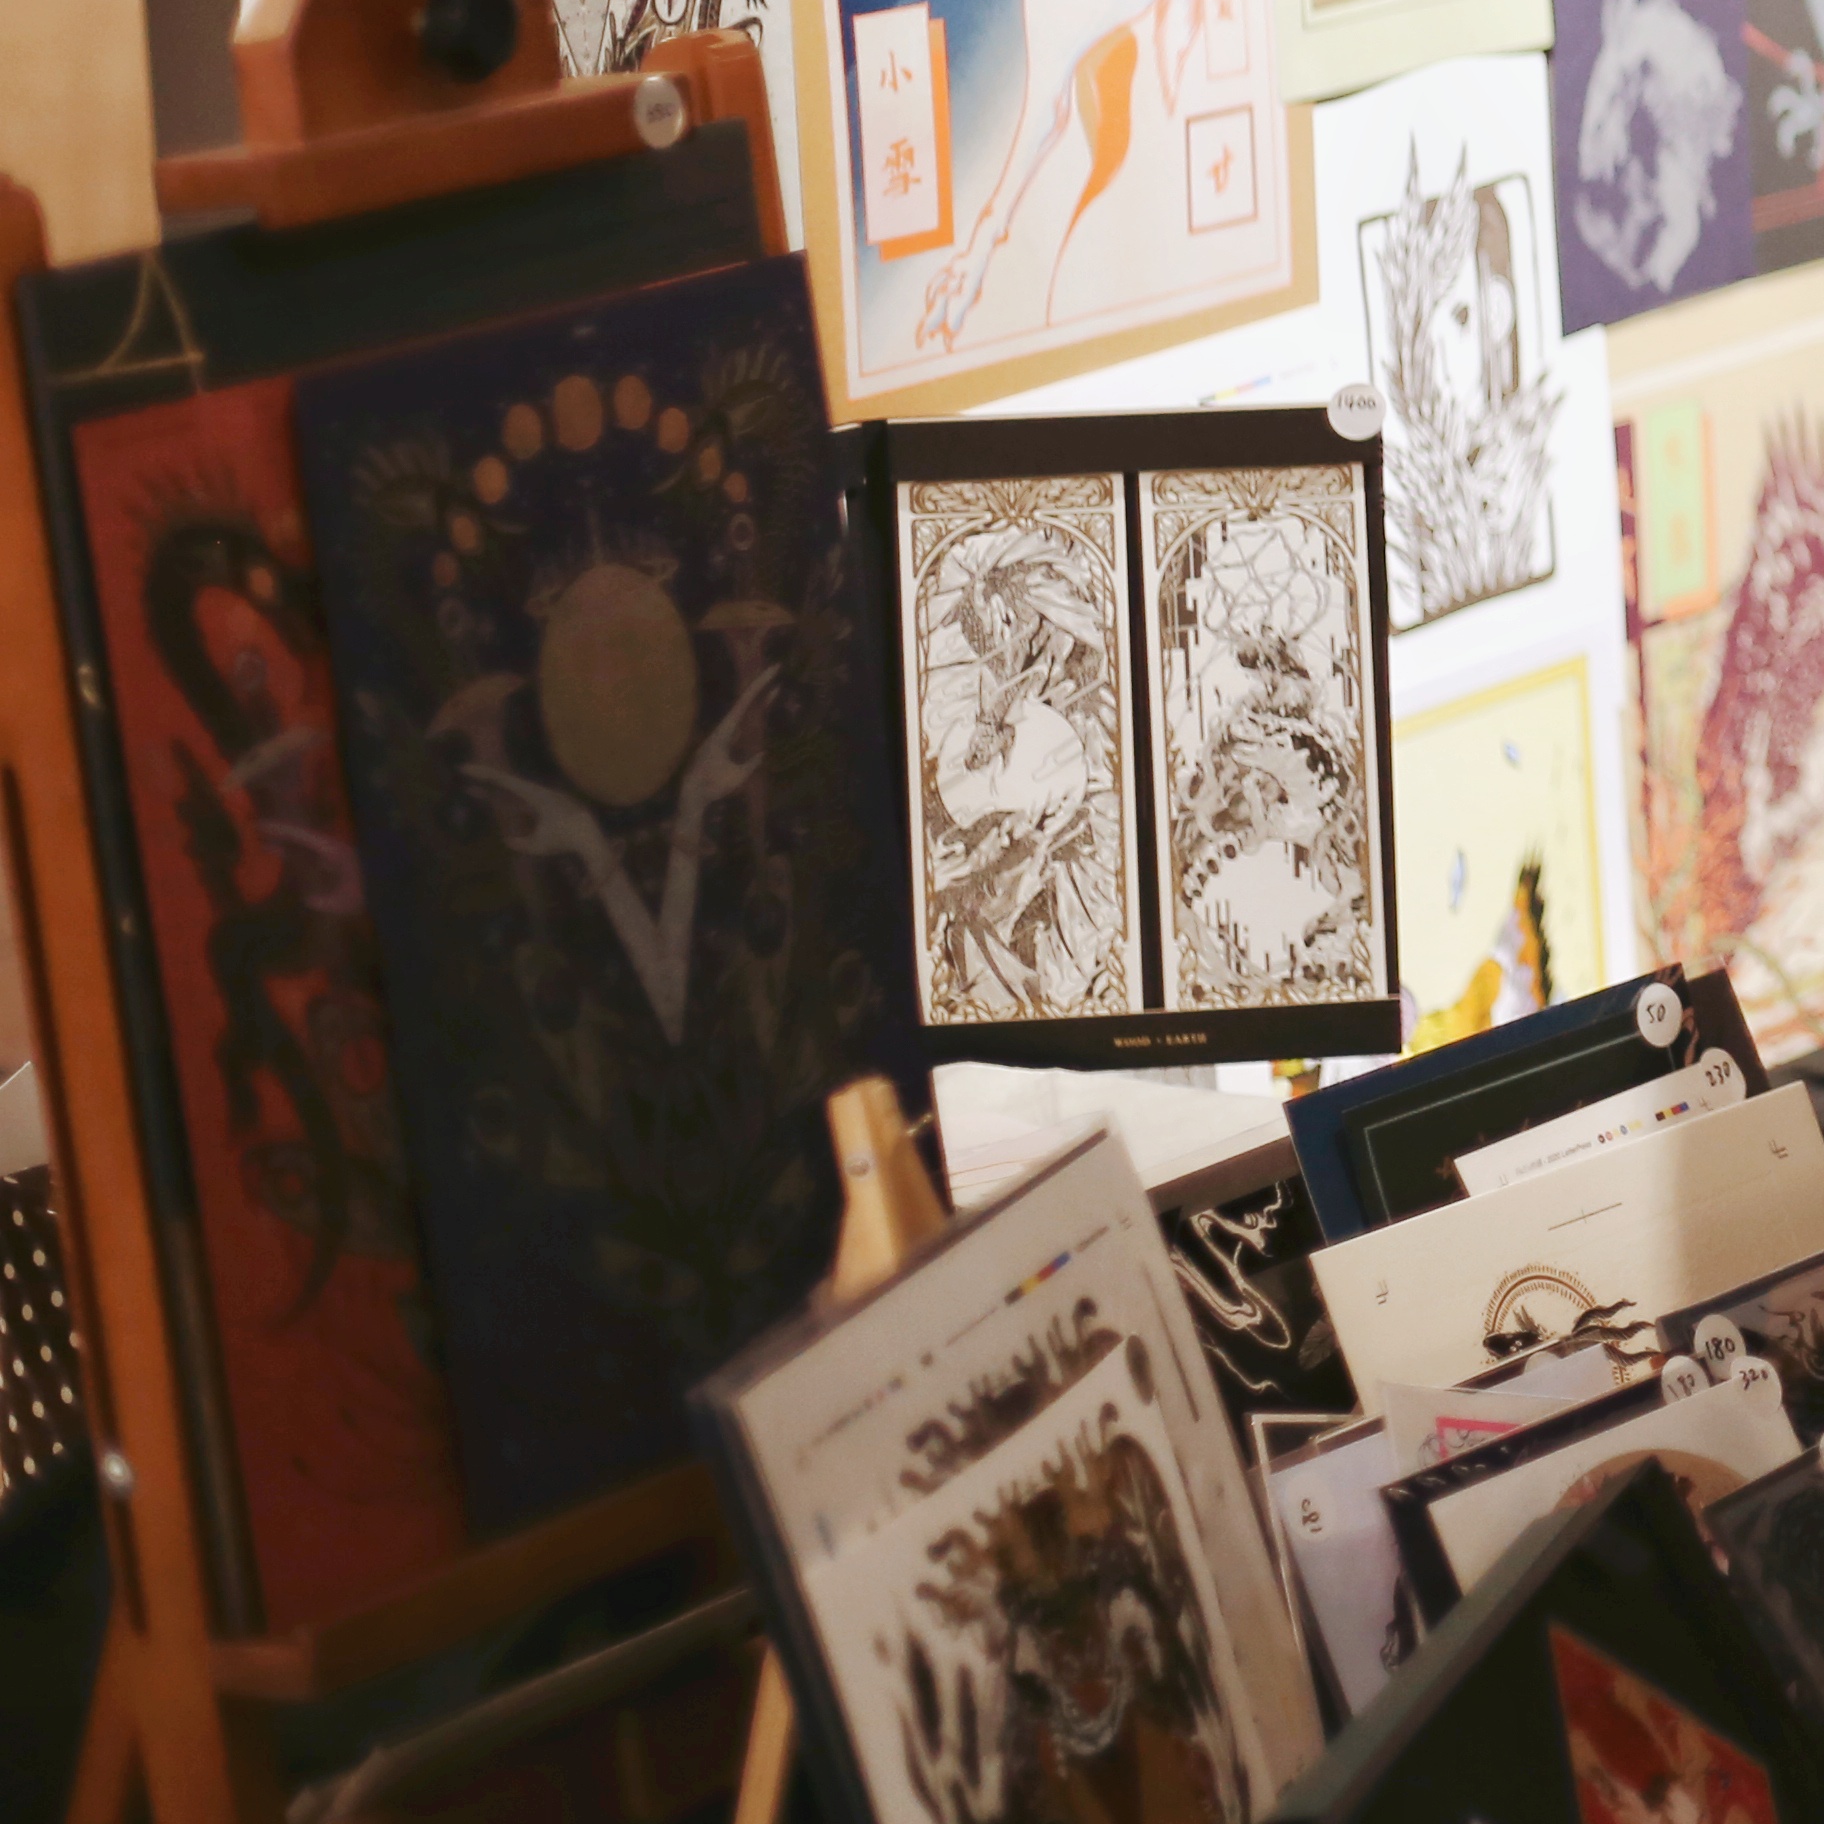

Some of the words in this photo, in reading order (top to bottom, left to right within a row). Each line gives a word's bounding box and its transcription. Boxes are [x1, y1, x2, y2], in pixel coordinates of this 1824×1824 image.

[880, 50, 921, 196] 小雪
[1646, 1004, 1666, 1024] 50
[1705, 1061, 1731, 1087] 230
[1705, 1337, 1736, 1361] 180
